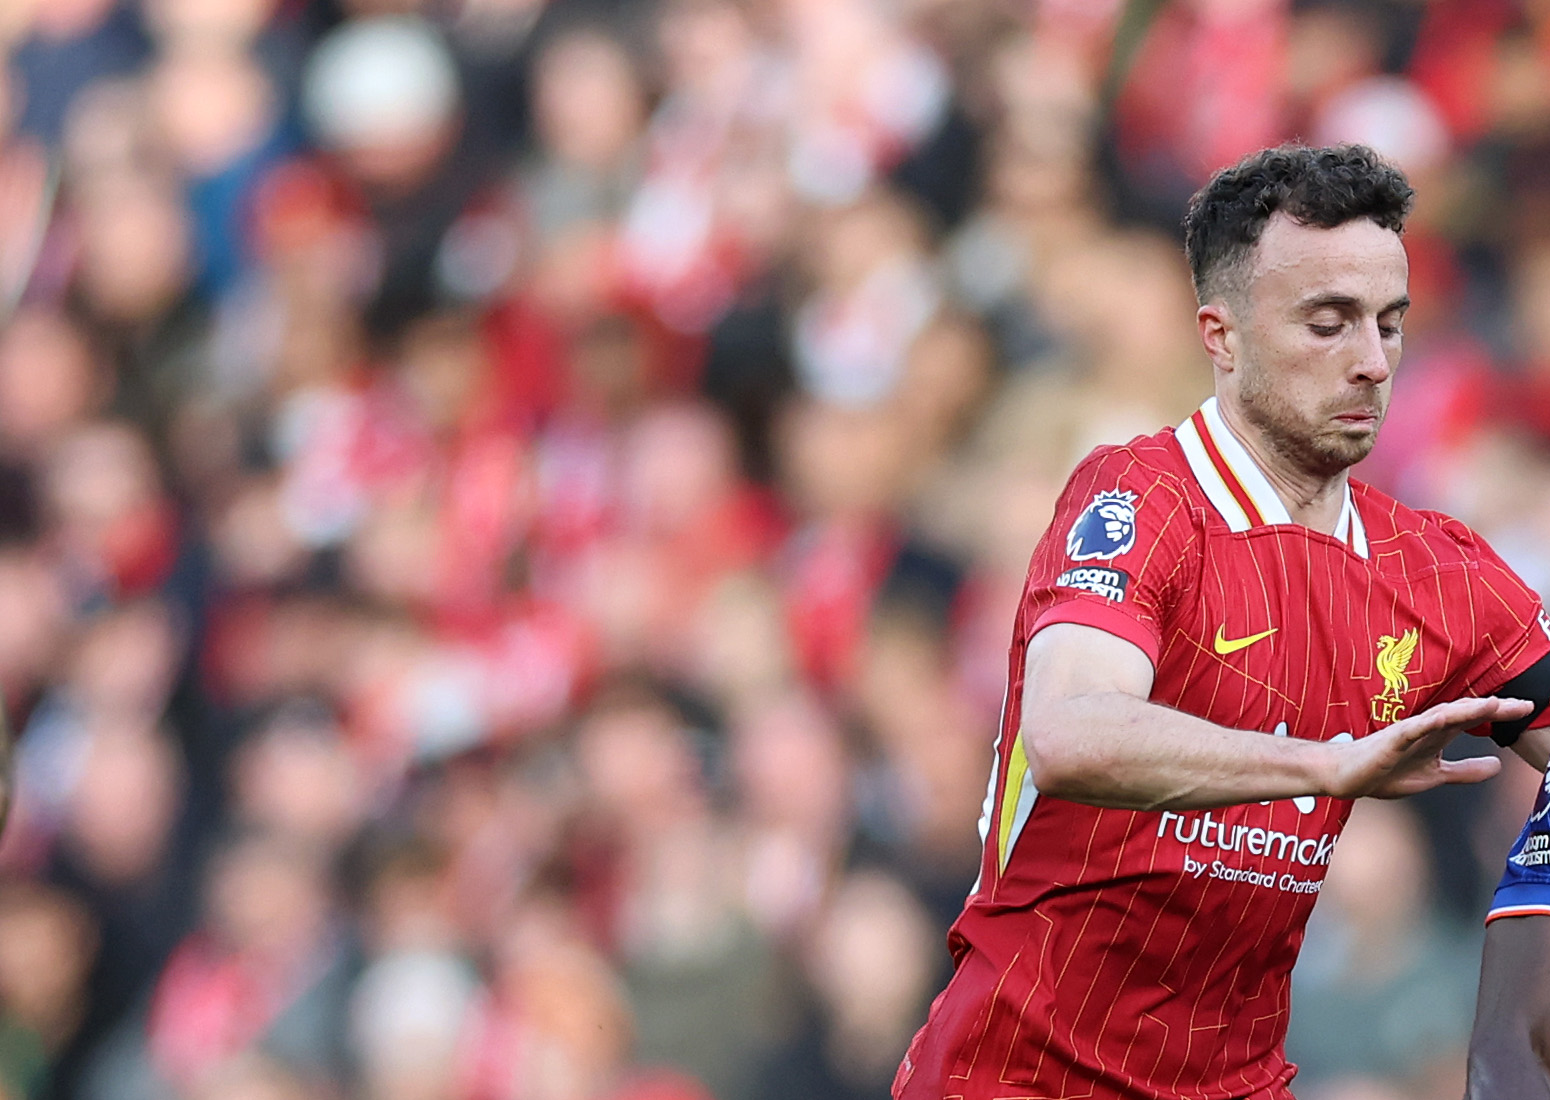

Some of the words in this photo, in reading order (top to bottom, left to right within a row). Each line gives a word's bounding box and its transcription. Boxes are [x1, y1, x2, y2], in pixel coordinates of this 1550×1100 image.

[1070, 568, 1119, 587] room
[1157, 810, 1338, 866] Futuremak
[1184, 855, 1207, 879] by
[1209, 861, 1277, 889] Standard
